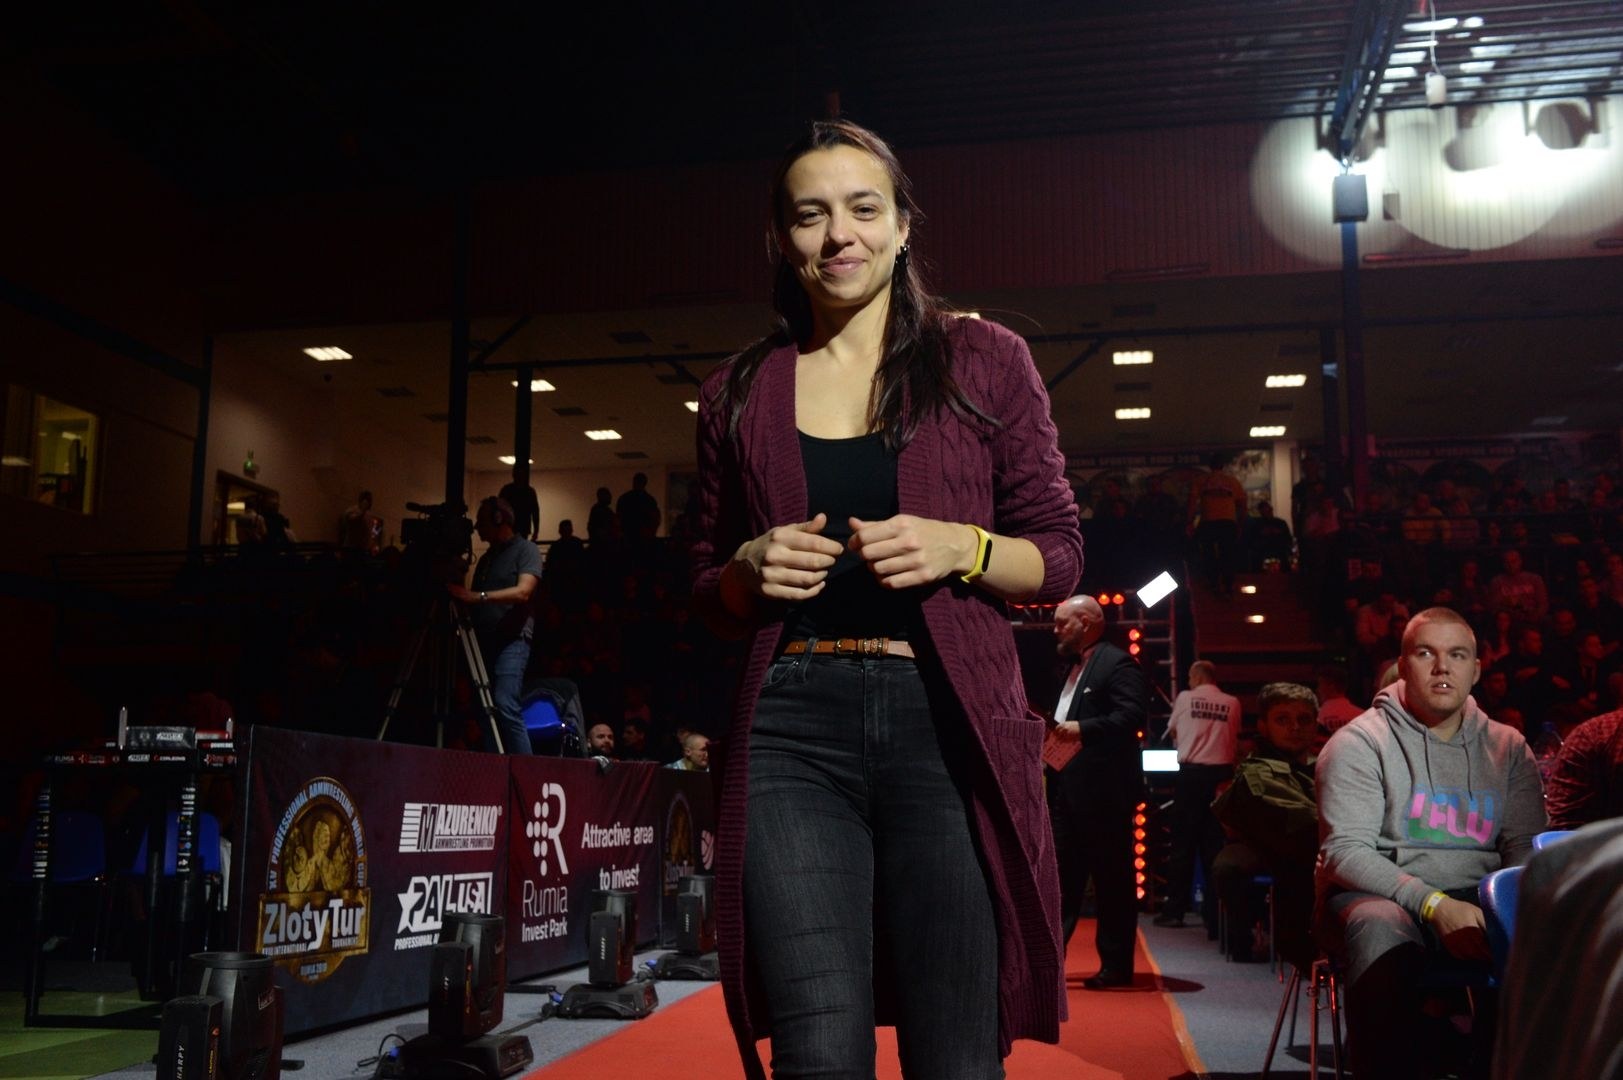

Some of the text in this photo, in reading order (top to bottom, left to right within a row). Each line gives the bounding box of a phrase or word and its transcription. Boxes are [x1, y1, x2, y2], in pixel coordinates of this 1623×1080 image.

[271, 788, 309, 865] PROFESSIONAL
[581, 821, 654, 849] Attractive area
[599, 867, 611, 891] to
[611, 862, 640, 889] invest
[522, 877, 568, 918] Rumia
[522, 917, 568, 942] Invest Park
